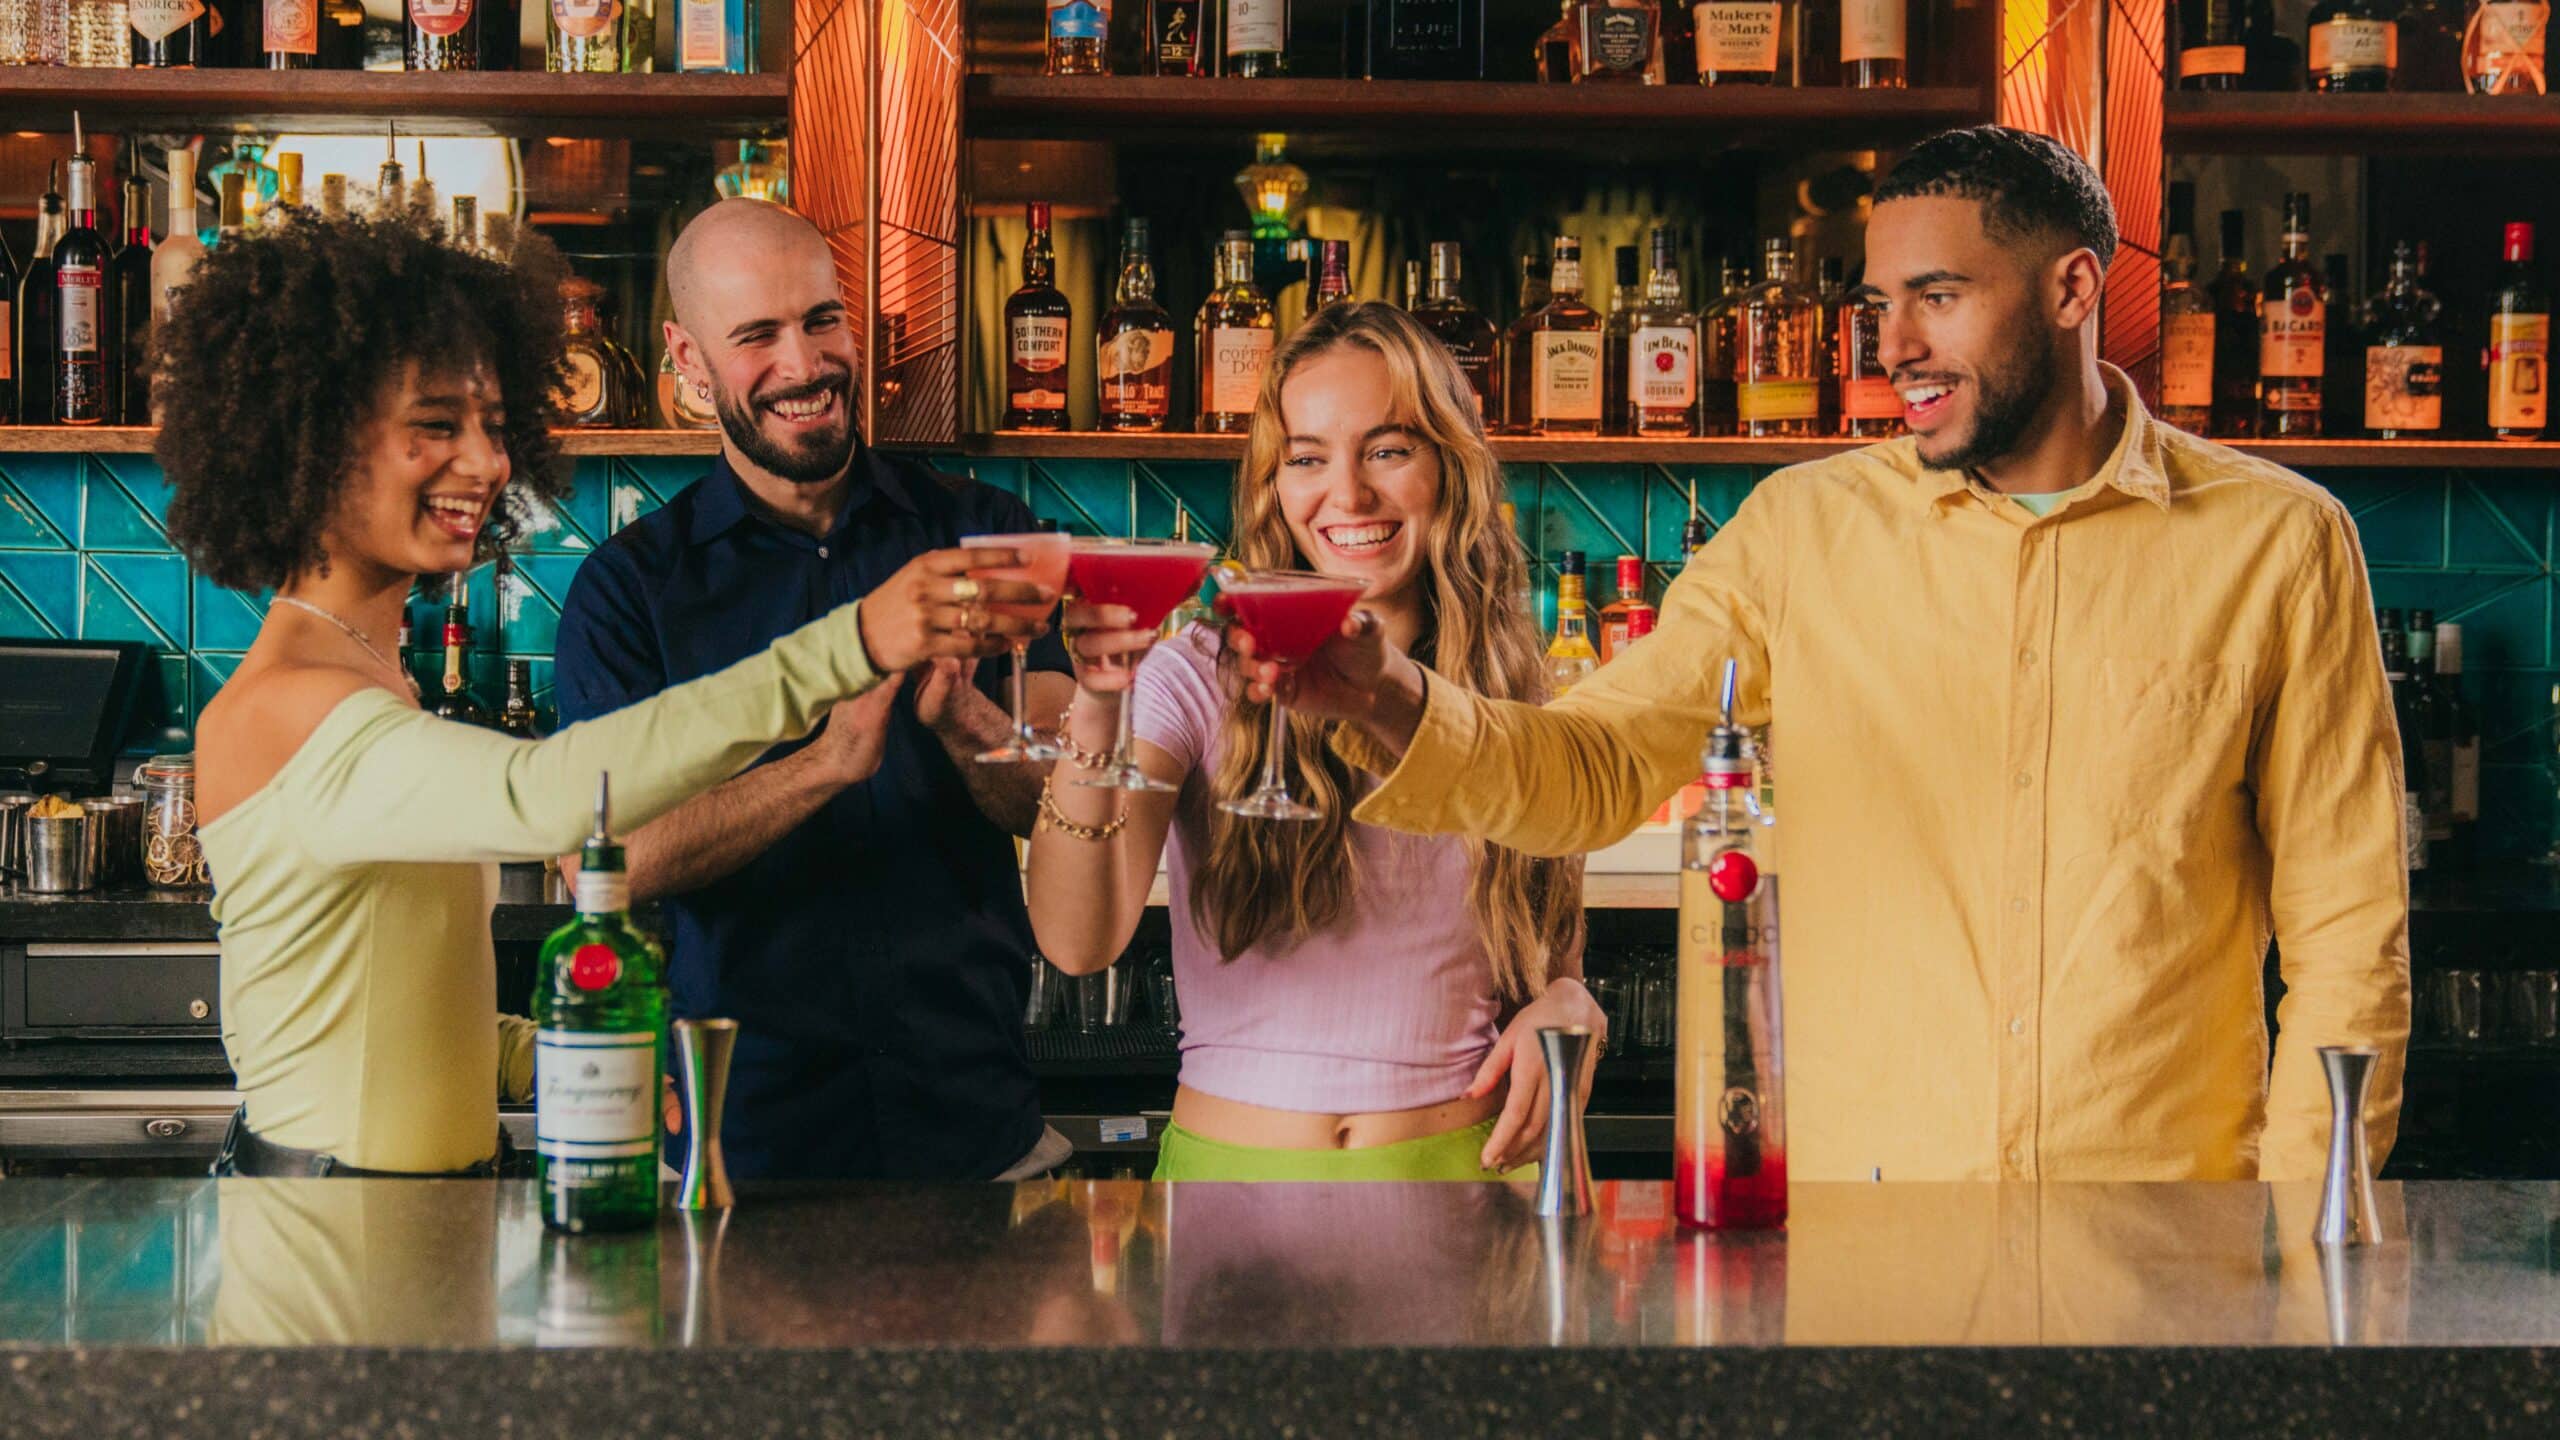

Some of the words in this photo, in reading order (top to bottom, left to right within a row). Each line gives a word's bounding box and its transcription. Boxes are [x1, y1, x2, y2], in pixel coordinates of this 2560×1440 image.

[130, 0, 195, 11] ENDRICK'S
[1710, 9, 1772, 21] Maker's
[1728, 23, 1770, 34] Mark
[1171, 46, 1182, 56] 12
[1017, 340, 1061, 352] COMFORT
